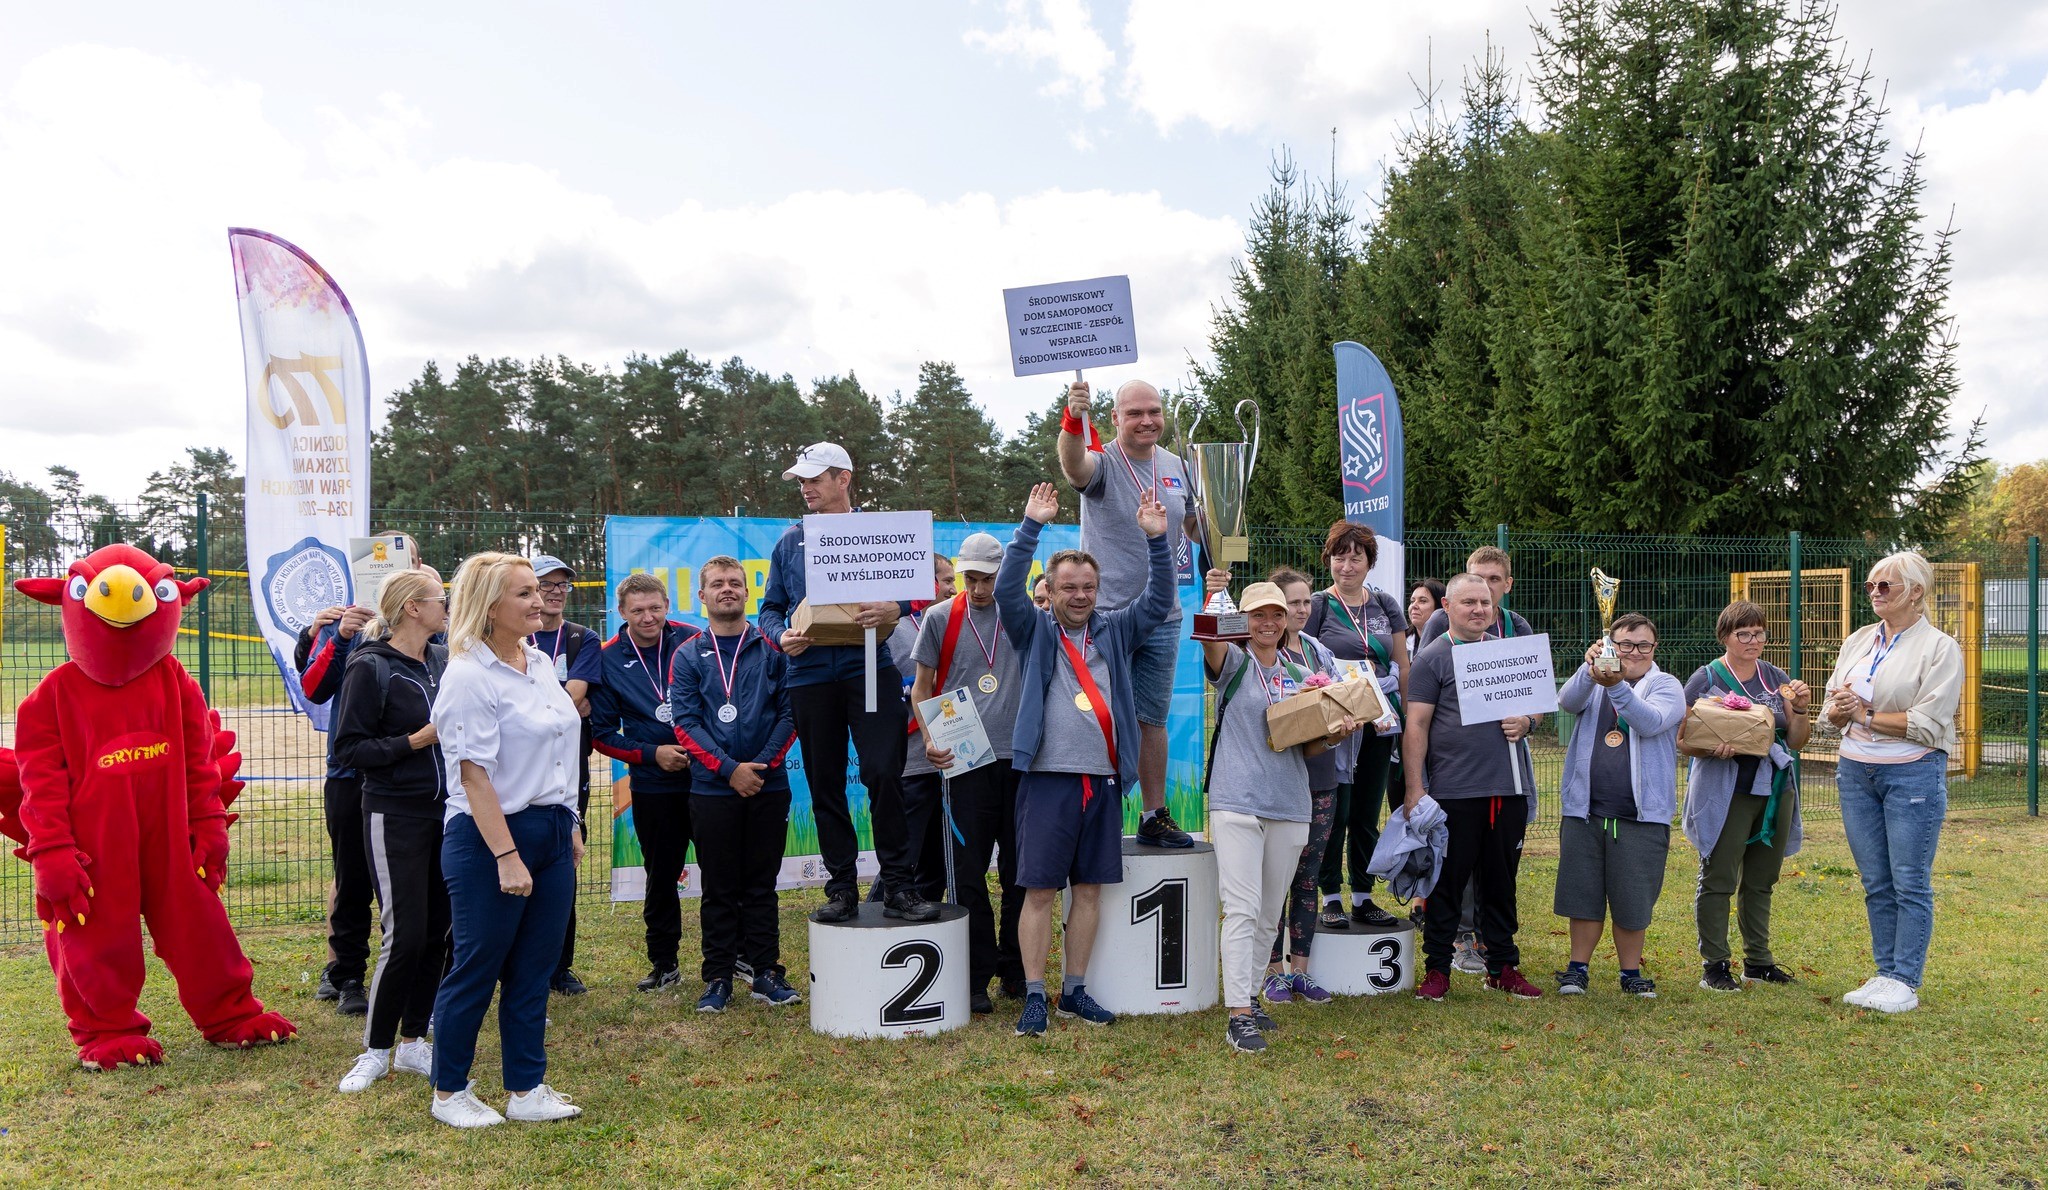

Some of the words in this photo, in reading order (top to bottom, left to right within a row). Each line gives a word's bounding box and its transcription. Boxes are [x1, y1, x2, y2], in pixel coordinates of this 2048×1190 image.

[1029, 290, 1105, 306] ŚRODOWISKOWY
[1024, 312, 1046, 321] DOM
[1048, 303, 1113, 318] SAMOPOMOCY
[1019, 328, 1029, 336] W
[1030, 322, 1082, 335] SZCZECINIE
[1090, 315, 1123, 327] ZESPÓŁ
[1049, 334, 1097, 346] WSPARCIA
[1018, 347, 1107, 364] ŚRODOWISKOWEGO
[1109, 345, 1122, 353] NR
[820, 534, 916, 546] ŚRODOWISKOWY
[813, 555, 840, 564] DOM
[844, 551, 926, 563] SAMOPOMOCY
[828, 572, 838, 581] W
[841, 568, 914, 581] MYŚLIBORZU
[1466, 655, 1538, 673] ŚRODOWISKOWY
[1463, 679, 1484, 689] DOM
[1486, 669, 1547, 686] SAMOPOMOCY
[1484, 693, 1492, 701] W
[1495, 687, 1532, 700] CHOJNIE
[97, 742, 170, 768] GRYFINO
[1130, 878, 1188, 990] 1
[1366, 937, 1402, 990] 3
[880, 939, 944, 1026] 2
